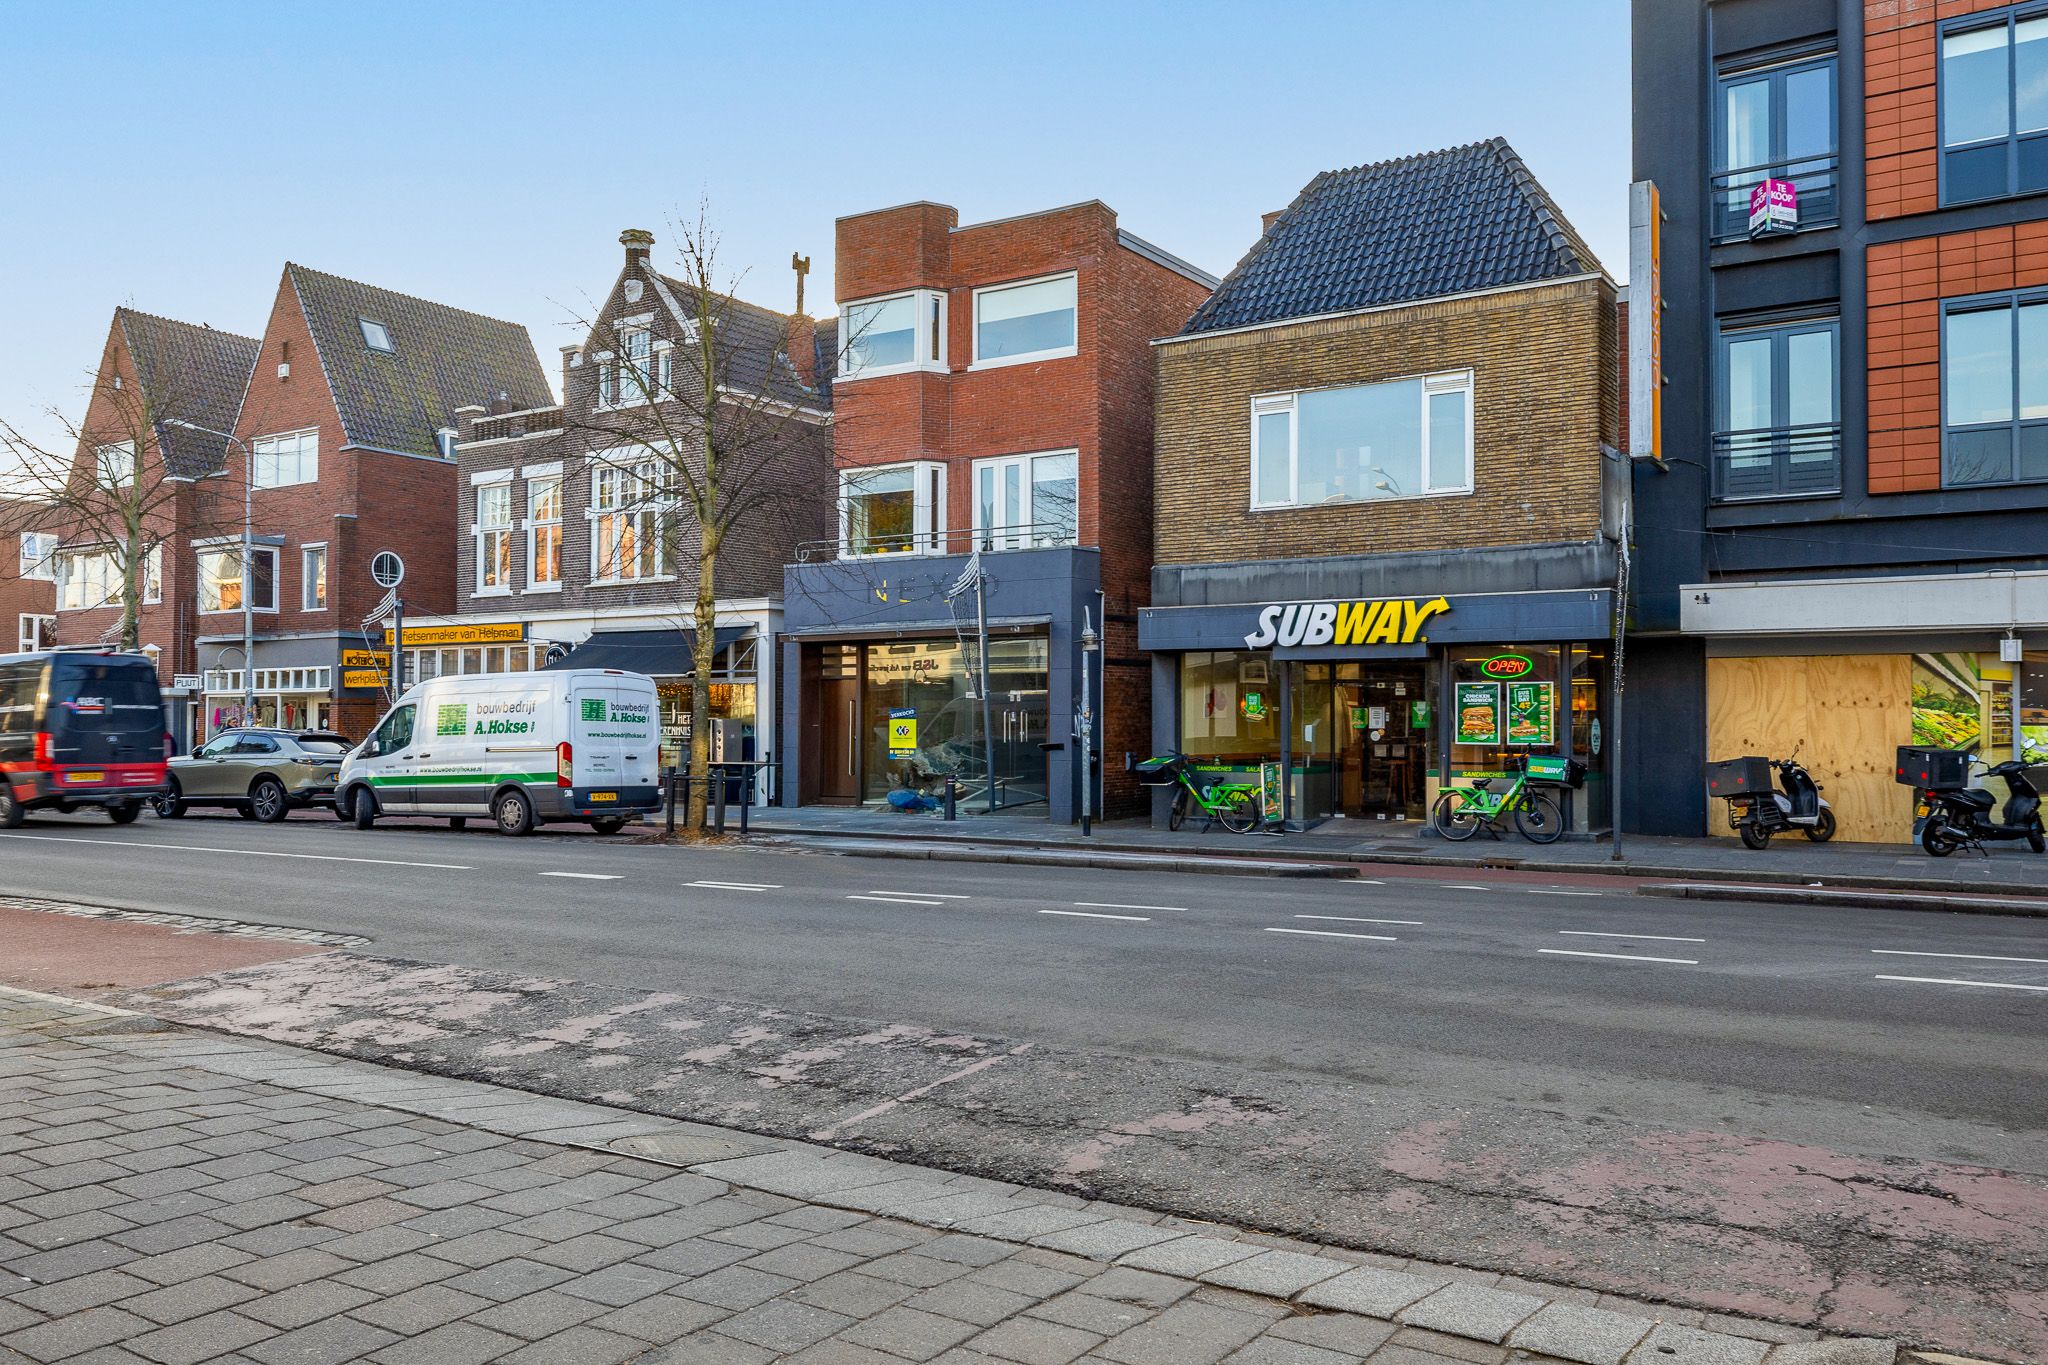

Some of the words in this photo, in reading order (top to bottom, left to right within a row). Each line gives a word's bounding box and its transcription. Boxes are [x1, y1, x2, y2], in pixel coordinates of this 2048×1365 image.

[1776, 183, 1787, 193] TE
[1770, 190, 1793, 202] KOOP
[1244, 596, 1450, 650] SUBWAY
[402, 628, 459, 642] fietsenmaker
[461, 631, 476, 640] van
[478, 628, 519, 641] Helpman
[1487, 660, 1526, 673] OPEN
[476, 700, 537, 715] bouwbedrijf
[610, 702, 650, 714] bouwbedrijf
[678, 715, 691, 725] HET
[1529, 765, 1563, 774] SUBWAY
